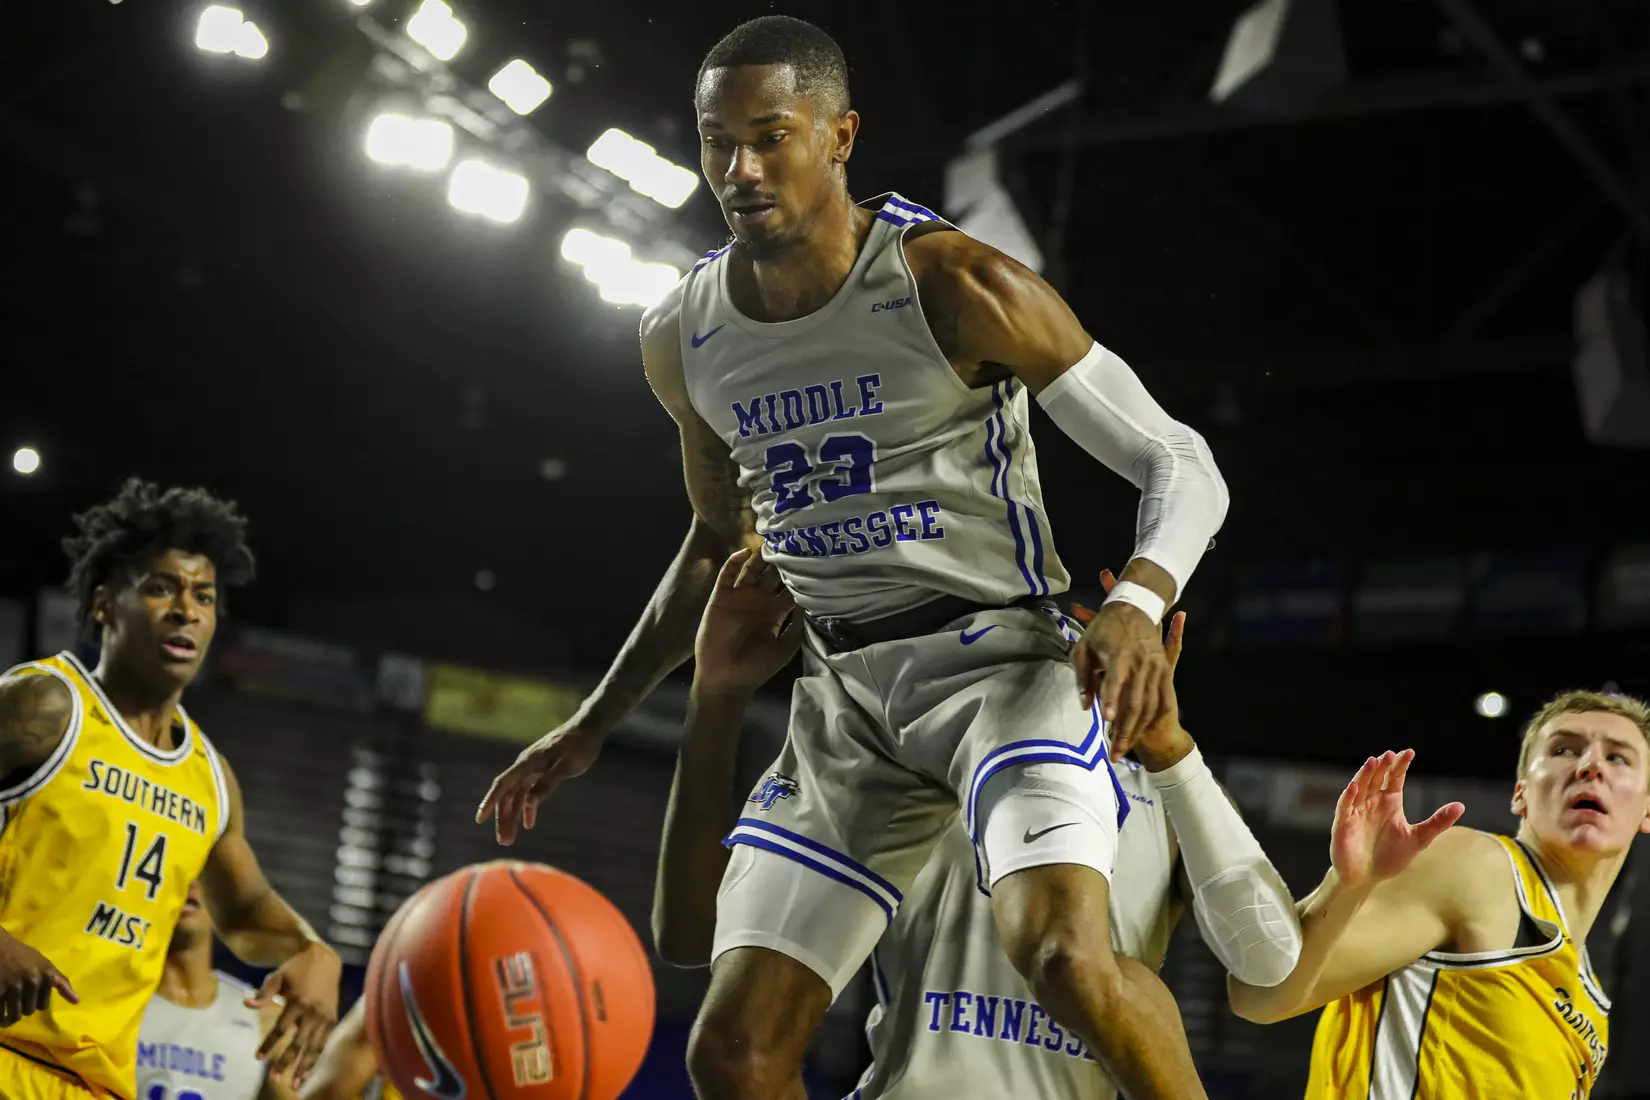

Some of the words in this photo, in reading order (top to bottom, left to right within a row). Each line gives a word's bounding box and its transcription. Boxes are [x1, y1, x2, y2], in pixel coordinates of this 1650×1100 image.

[731, 373, 884, 438] MIDDLE
[764, 431, 877, 517] 23
[764, 500, 945, 557] NNESSEE
[83, 760, 206, 835] SOUTHERN
[116, 821, 167, 901] 14
[924, 989, 1099, 1063] TENNESS
